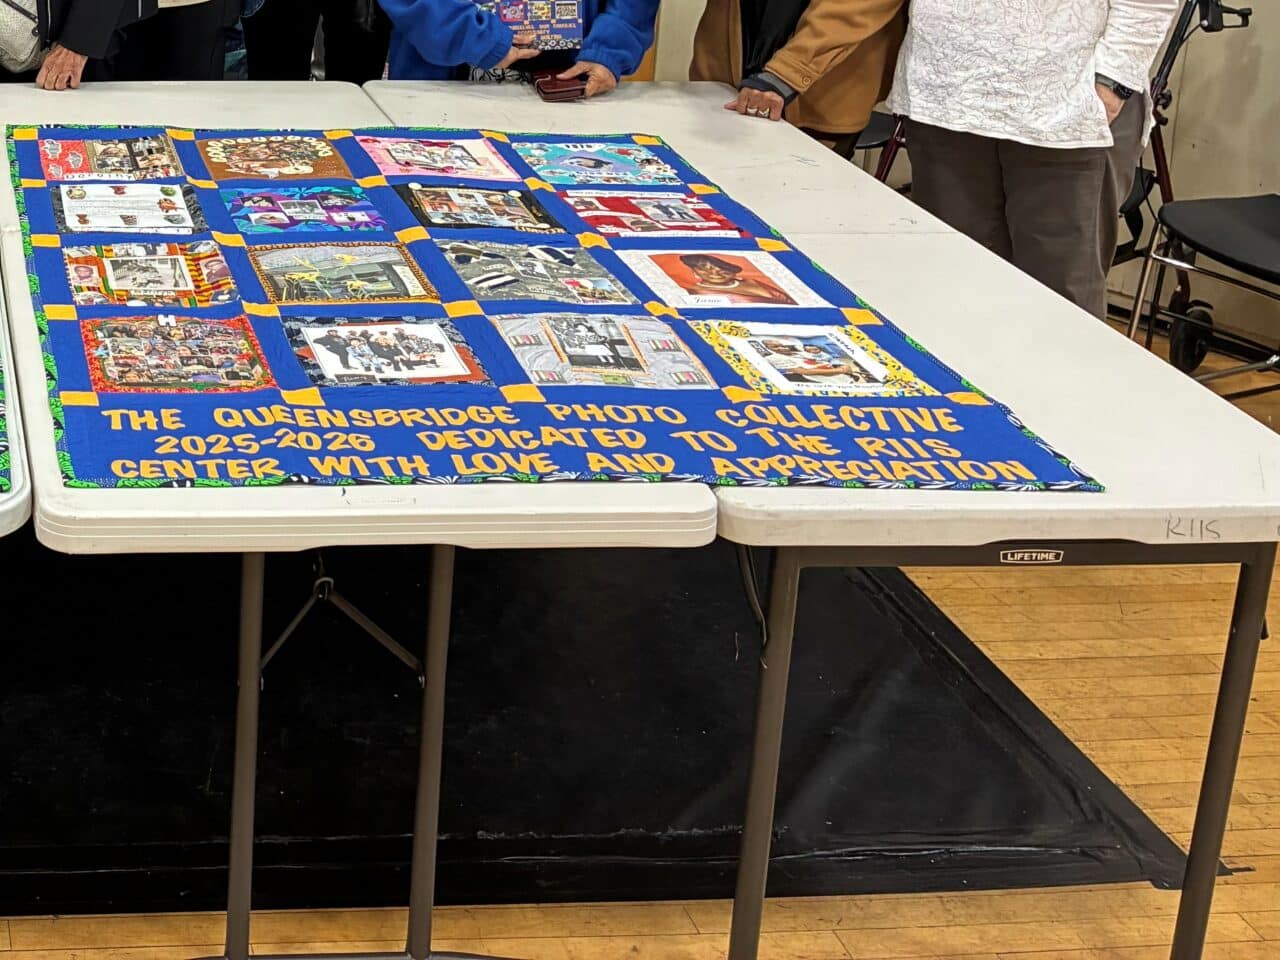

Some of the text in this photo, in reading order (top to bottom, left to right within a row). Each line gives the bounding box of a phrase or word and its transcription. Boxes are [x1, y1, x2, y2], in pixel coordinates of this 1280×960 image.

[101, 403, 964, 433] THE QUEENSBRIDGE PHOTO COLLECTIVE
[155, 426, 963, 460] 2025-2026 DEDICATED TO THE RIIS
[111, 452, 1036, 482] CENTER WITH LOVE AND APPRECIATION
[1007, 552, 1057, 561] LIFETIME
